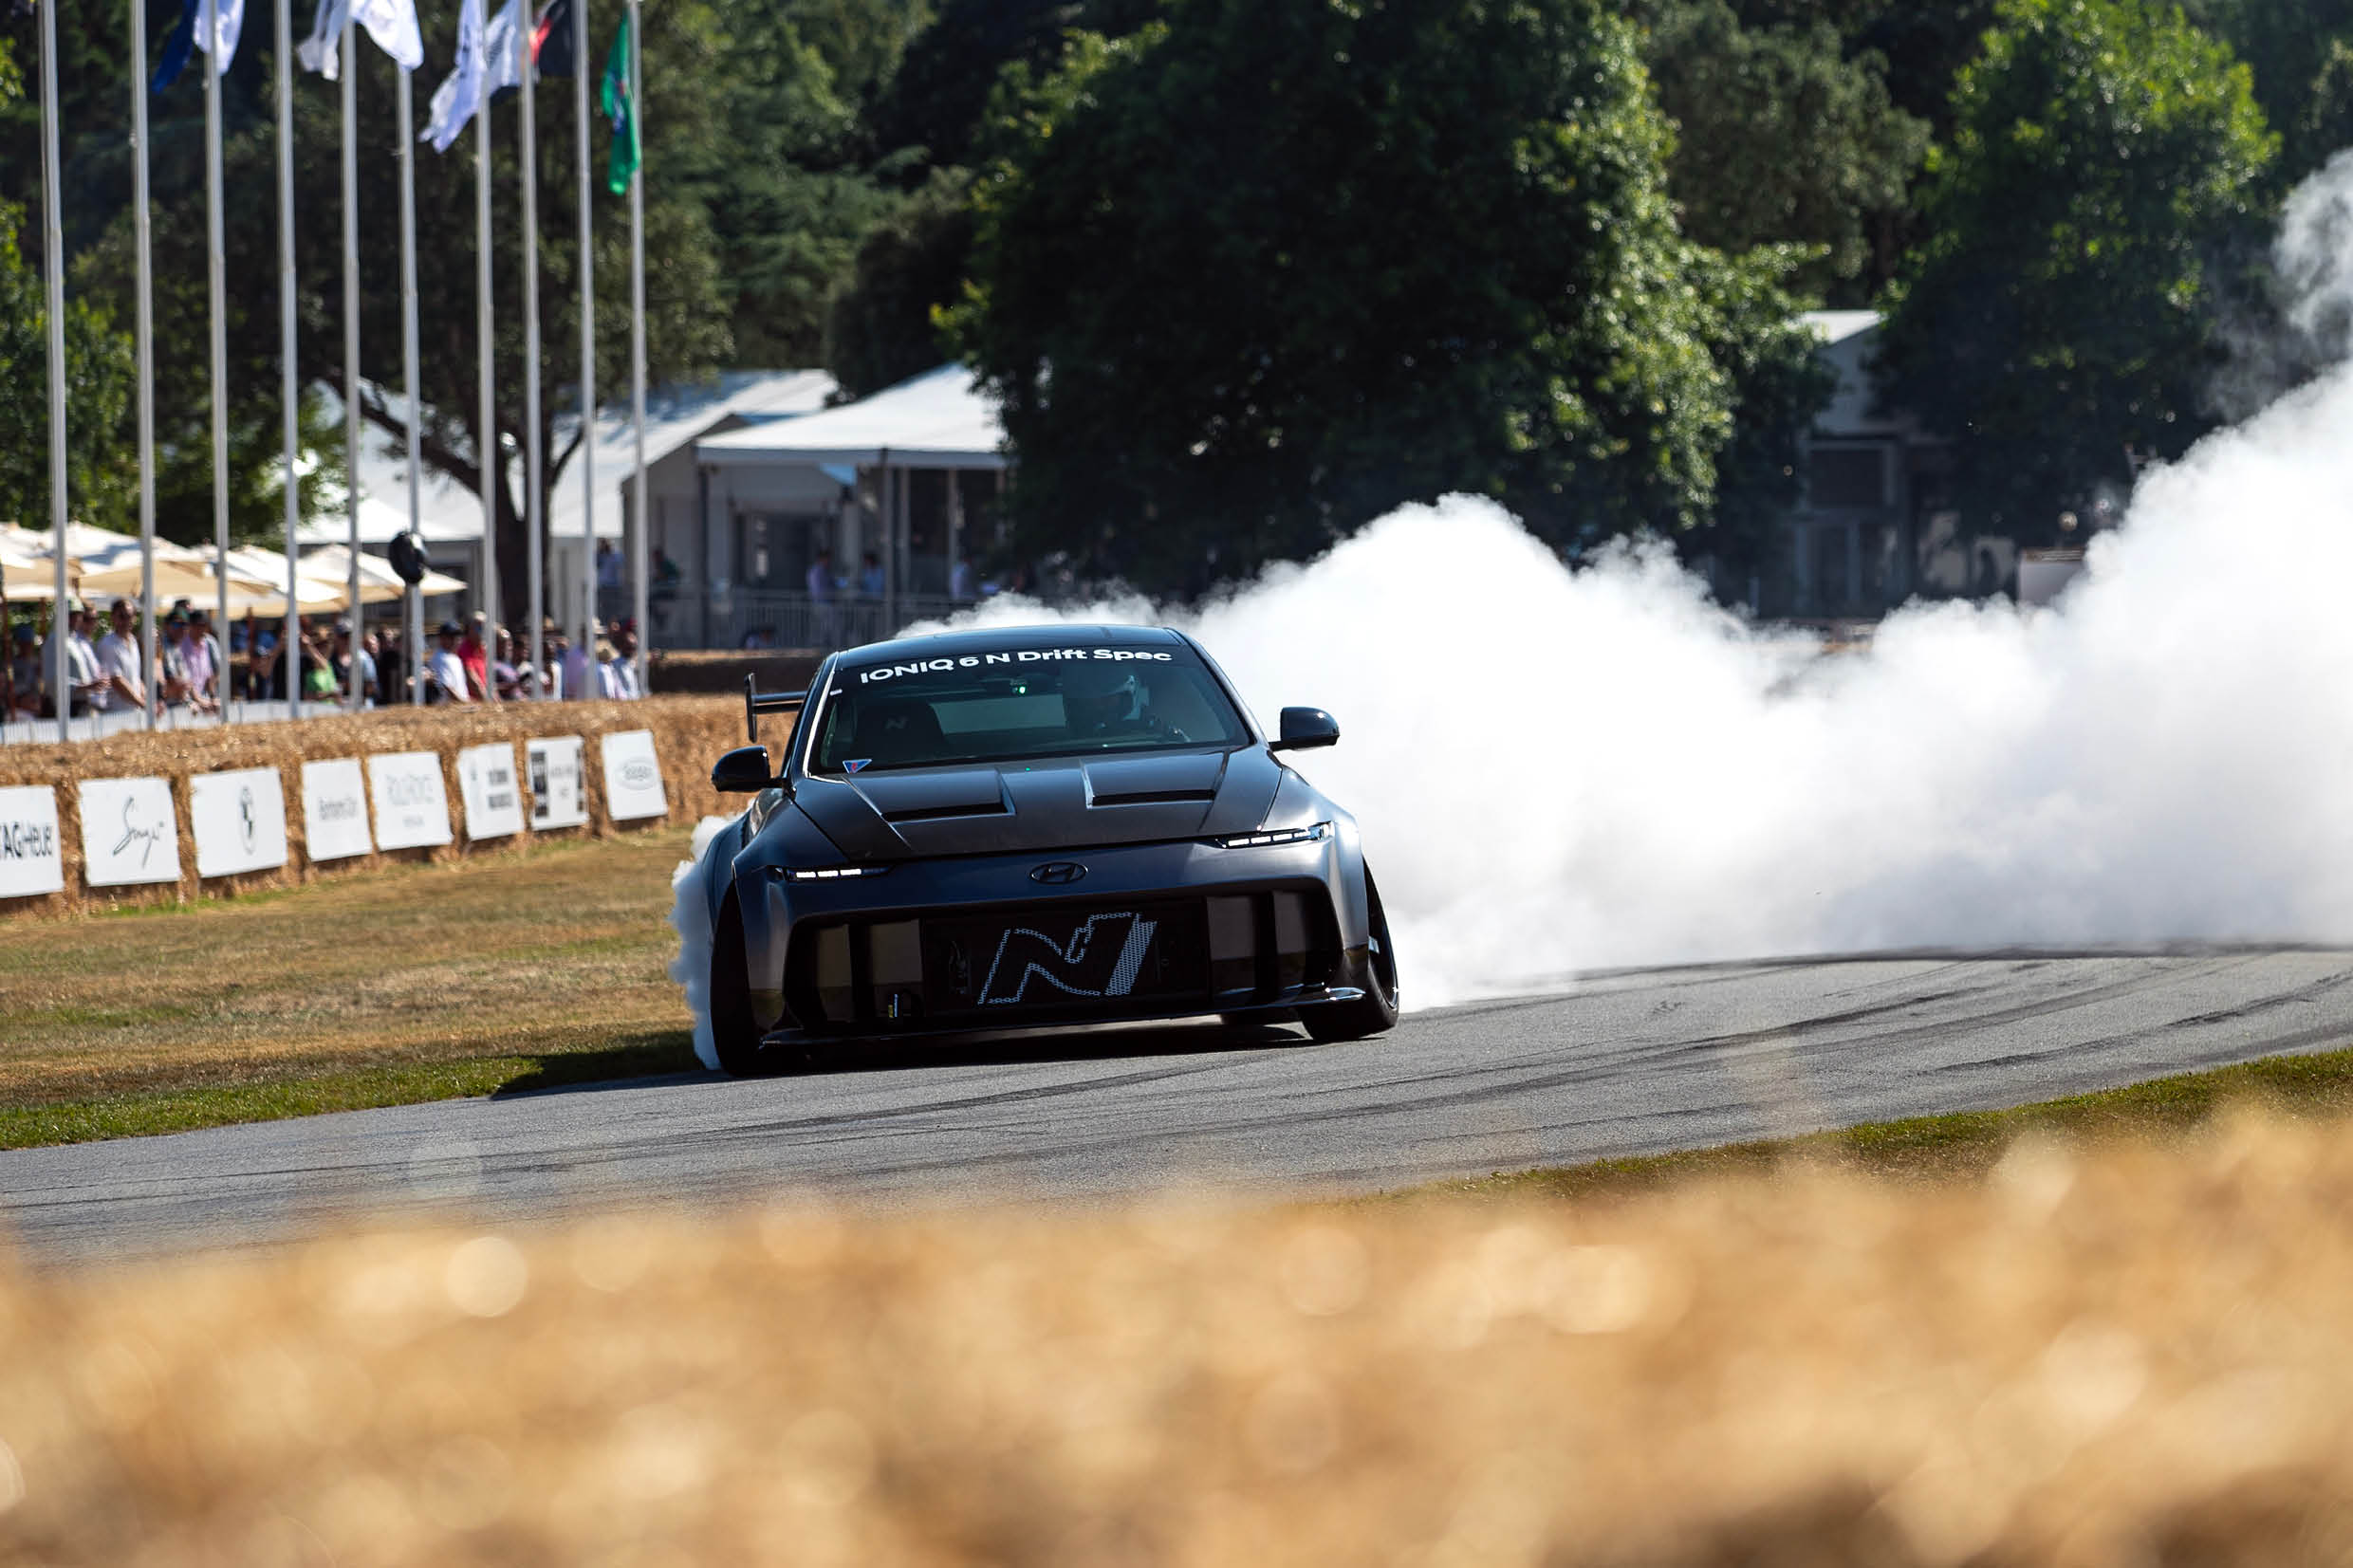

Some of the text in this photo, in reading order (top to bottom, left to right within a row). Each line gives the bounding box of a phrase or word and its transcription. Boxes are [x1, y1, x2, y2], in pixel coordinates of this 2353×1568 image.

[860, 649, 1173, 684] IONIQ 6 N Drift Spec
